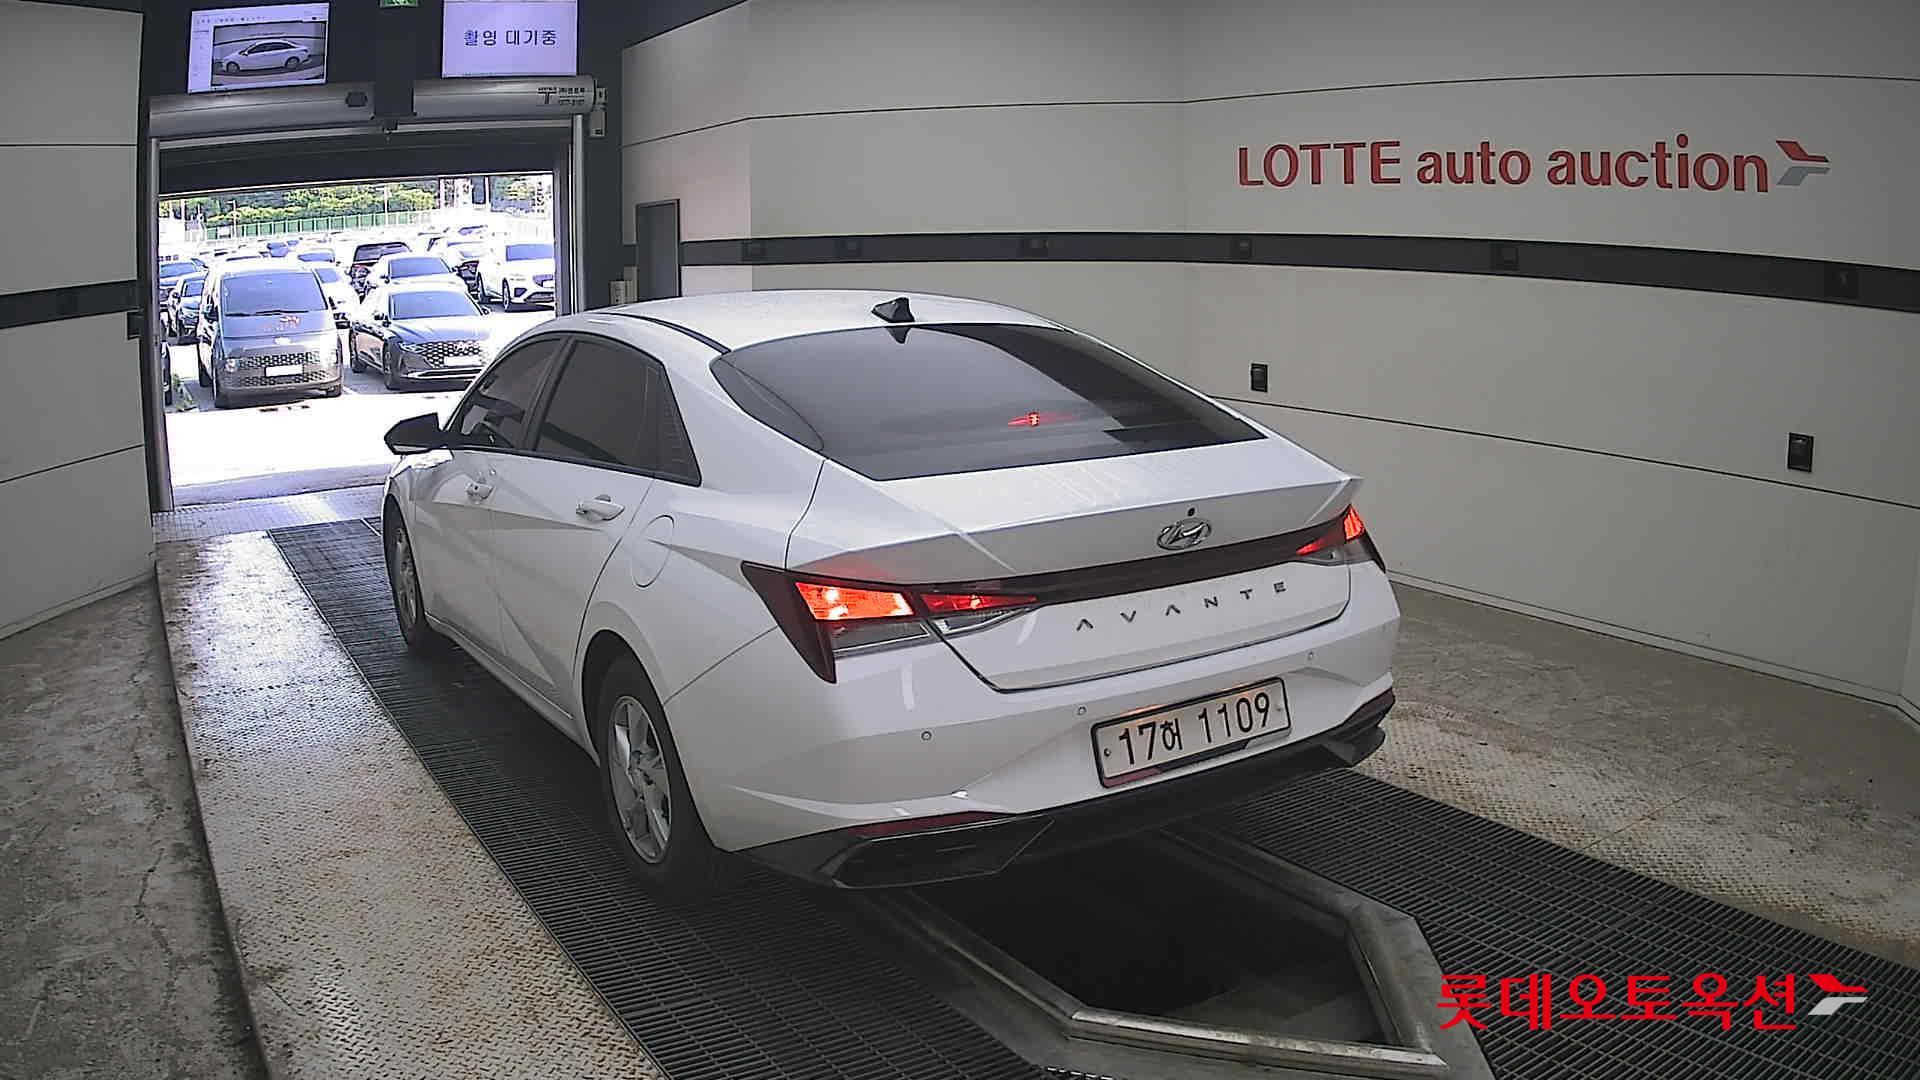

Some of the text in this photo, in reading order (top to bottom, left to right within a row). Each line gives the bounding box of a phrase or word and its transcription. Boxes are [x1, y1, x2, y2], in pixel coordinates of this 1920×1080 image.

[464, 30, 557, 46] 촬영 대기중
[1238, 133, 1769, 193] LOTTE auto auction
[1076, 580, 1287, 632] AVANTE
[1118, 692, 1270, 766] 17허 1109
